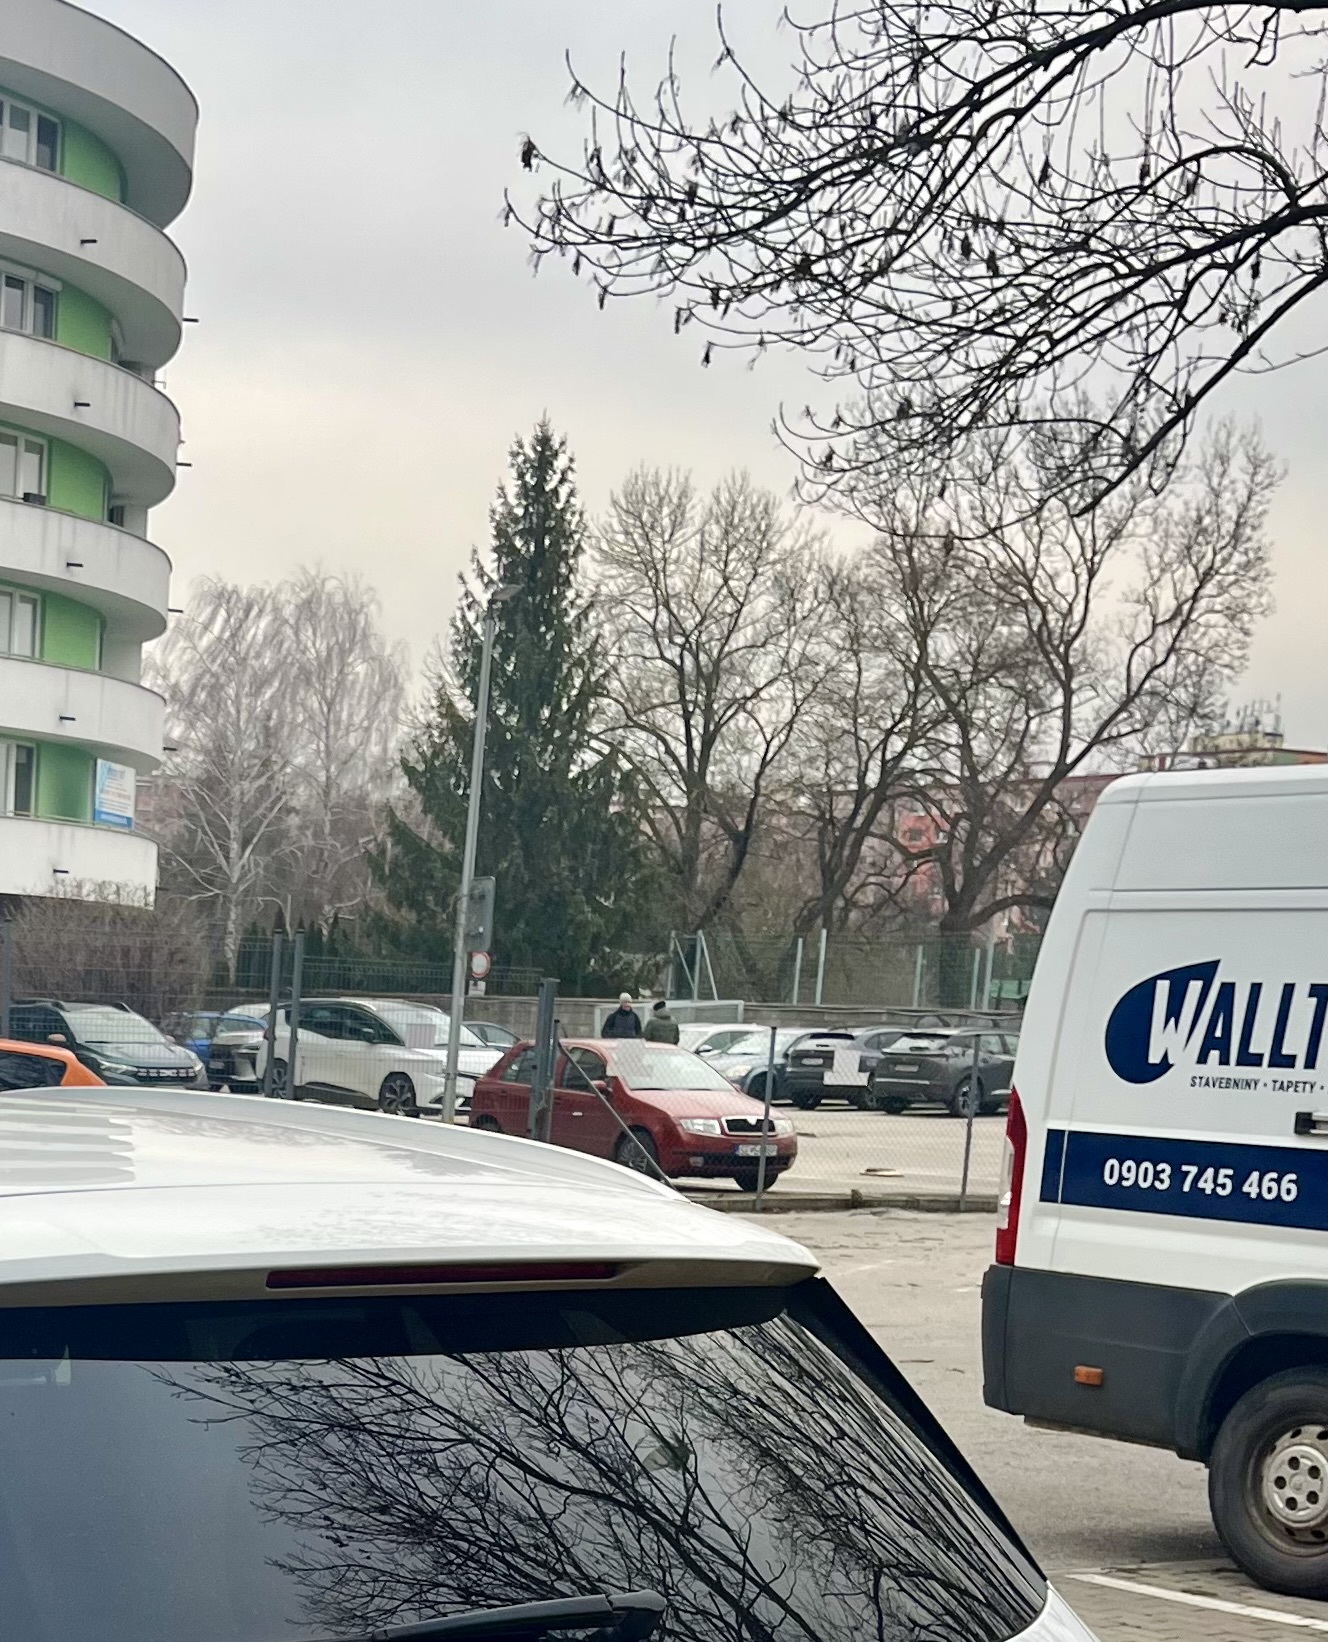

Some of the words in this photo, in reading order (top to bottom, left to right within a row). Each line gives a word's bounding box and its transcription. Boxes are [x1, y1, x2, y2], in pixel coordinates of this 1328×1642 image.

[1190, 1075, 1260, 1091] STAVEBNINY
[1272, 1079, 1317, 1094] TAPETY
[1103, 1157, 1172, 1191] 0903
[1180, 1164, 1234, 1196] 745
[1242, 1170, 1298, 1202] 466
